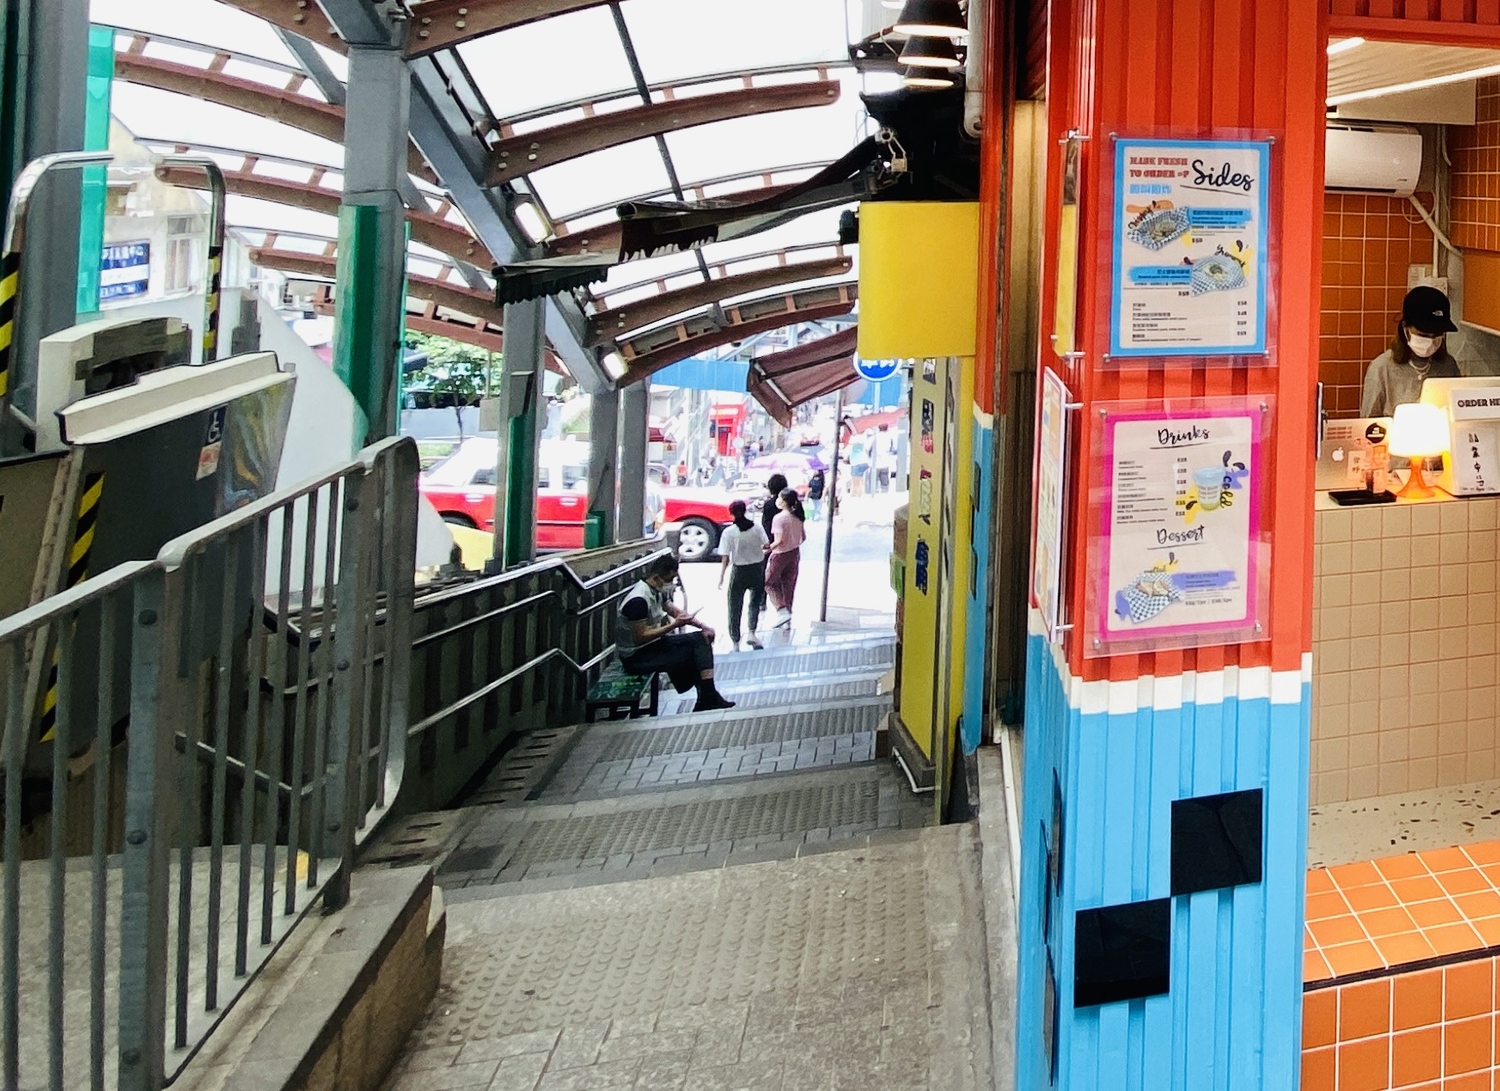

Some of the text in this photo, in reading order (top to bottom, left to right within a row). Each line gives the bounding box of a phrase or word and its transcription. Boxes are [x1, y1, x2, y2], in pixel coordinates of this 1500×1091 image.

[1157, 157, 1188, 165] FRESH
[1129, 169, 1142, 177] TO
[1143, 169, 1176, 178] ORDER
[1191, 159, 1254, 192] Sides
[1457, 398, 1488, 408] ORDER
[1157, 425, 1210, 446] Drinks
[1156, 525, 1205, 545] Dessert
